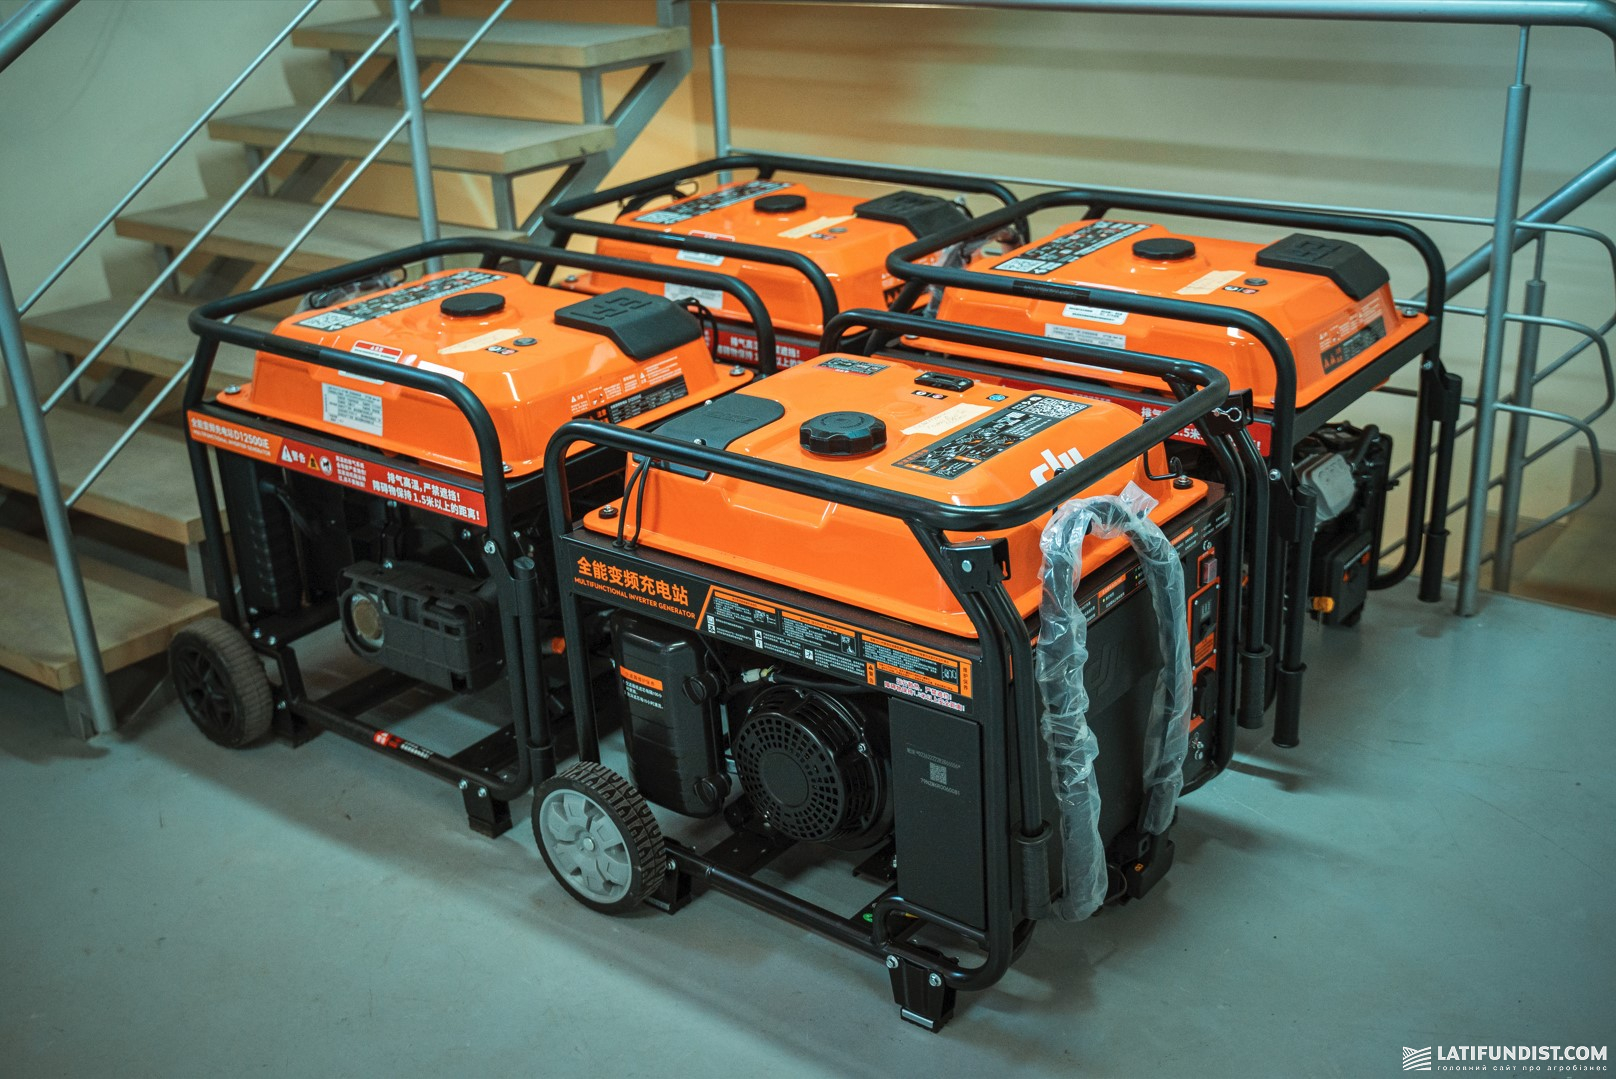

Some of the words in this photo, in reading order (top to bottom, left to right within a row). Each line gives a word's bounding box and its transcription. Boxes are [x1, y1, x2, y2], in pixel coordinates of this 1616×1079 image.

[574, 577, 629, 599] MULTIFUNCTIONAL
[629, 593, 658, 607] INVERTER
[658, 602, 696, 619] GENERATOR
[577, 556, 689, 606] 全能变频充电站
